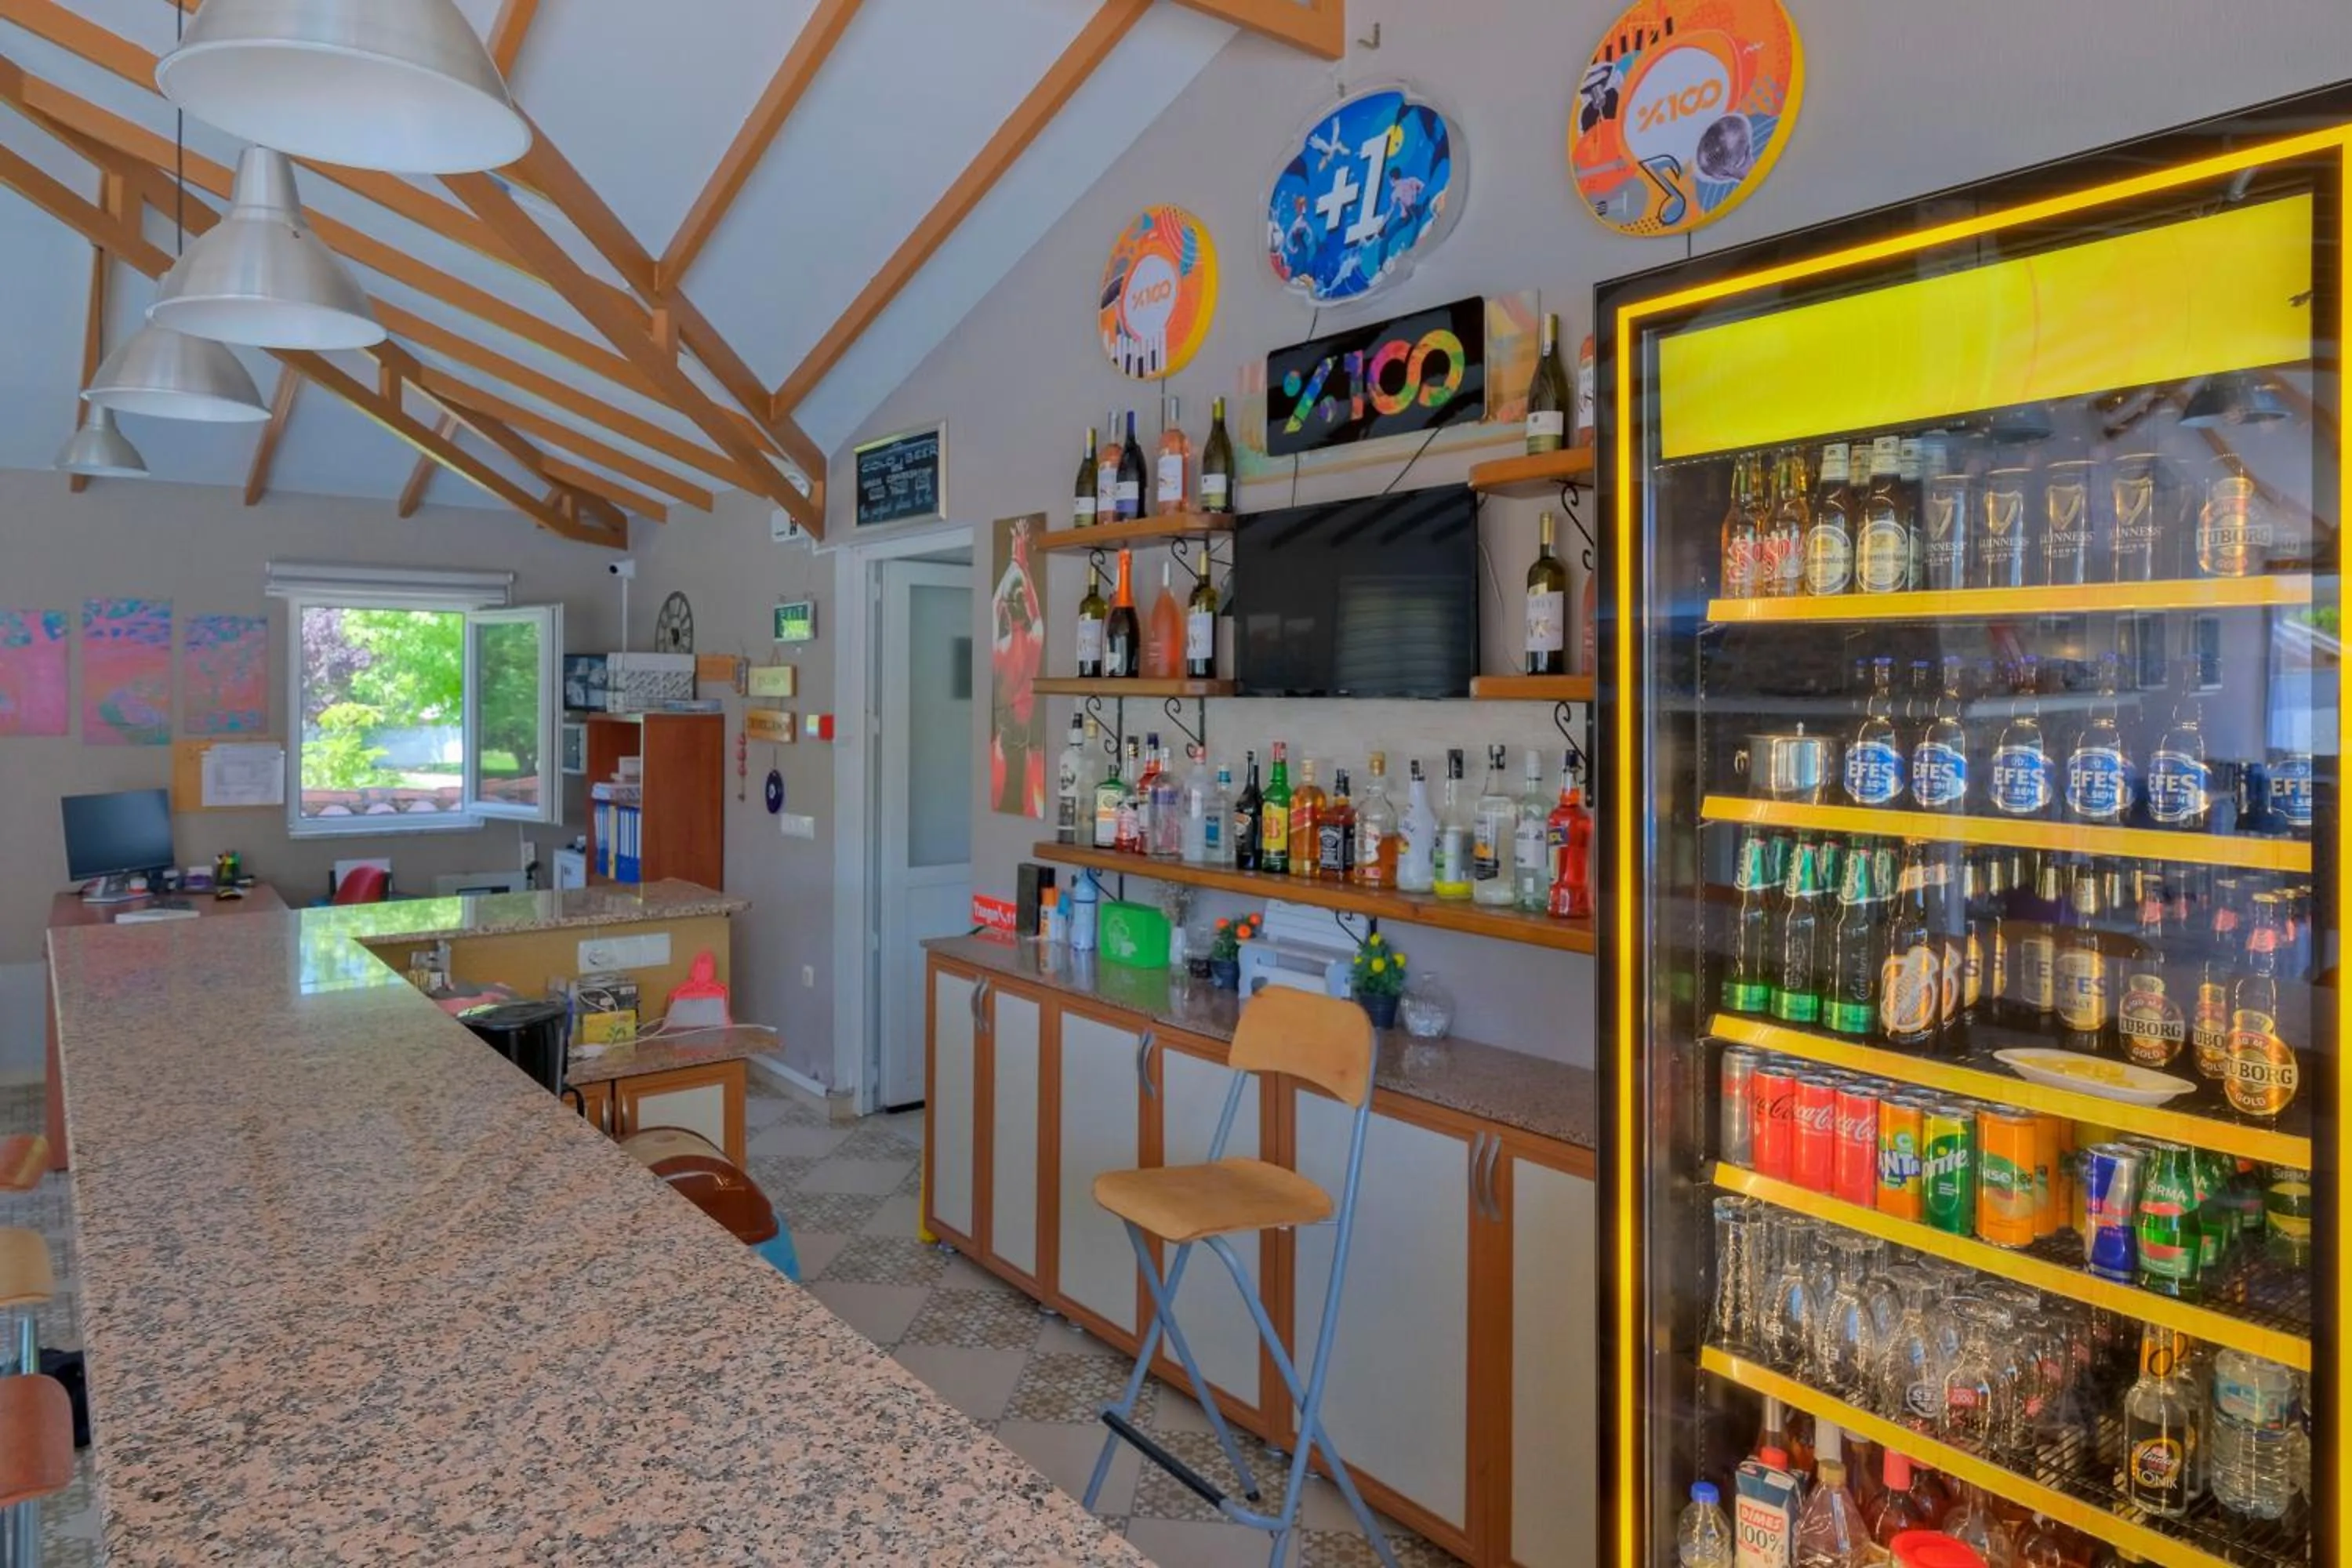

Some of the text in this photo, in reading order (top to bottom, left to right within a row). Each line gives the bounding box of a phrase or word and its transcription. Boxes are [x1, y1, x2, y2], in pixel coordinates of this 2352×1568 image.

[1638, 79, 1722, 132] %100
[1131, 279, 1171, 312] %100
[1283, 329, 1465, 433] %100
[1848, 762, 1895, 779] EFES
[1912, 761, 1956, 780] EFES
[1993, 766, 2045, 785] EFES
[2070, 769, 2125, 790] EFES
[2147, 772, 2198, 794] EFES
[2271, 777, 2310, 797] EFE
